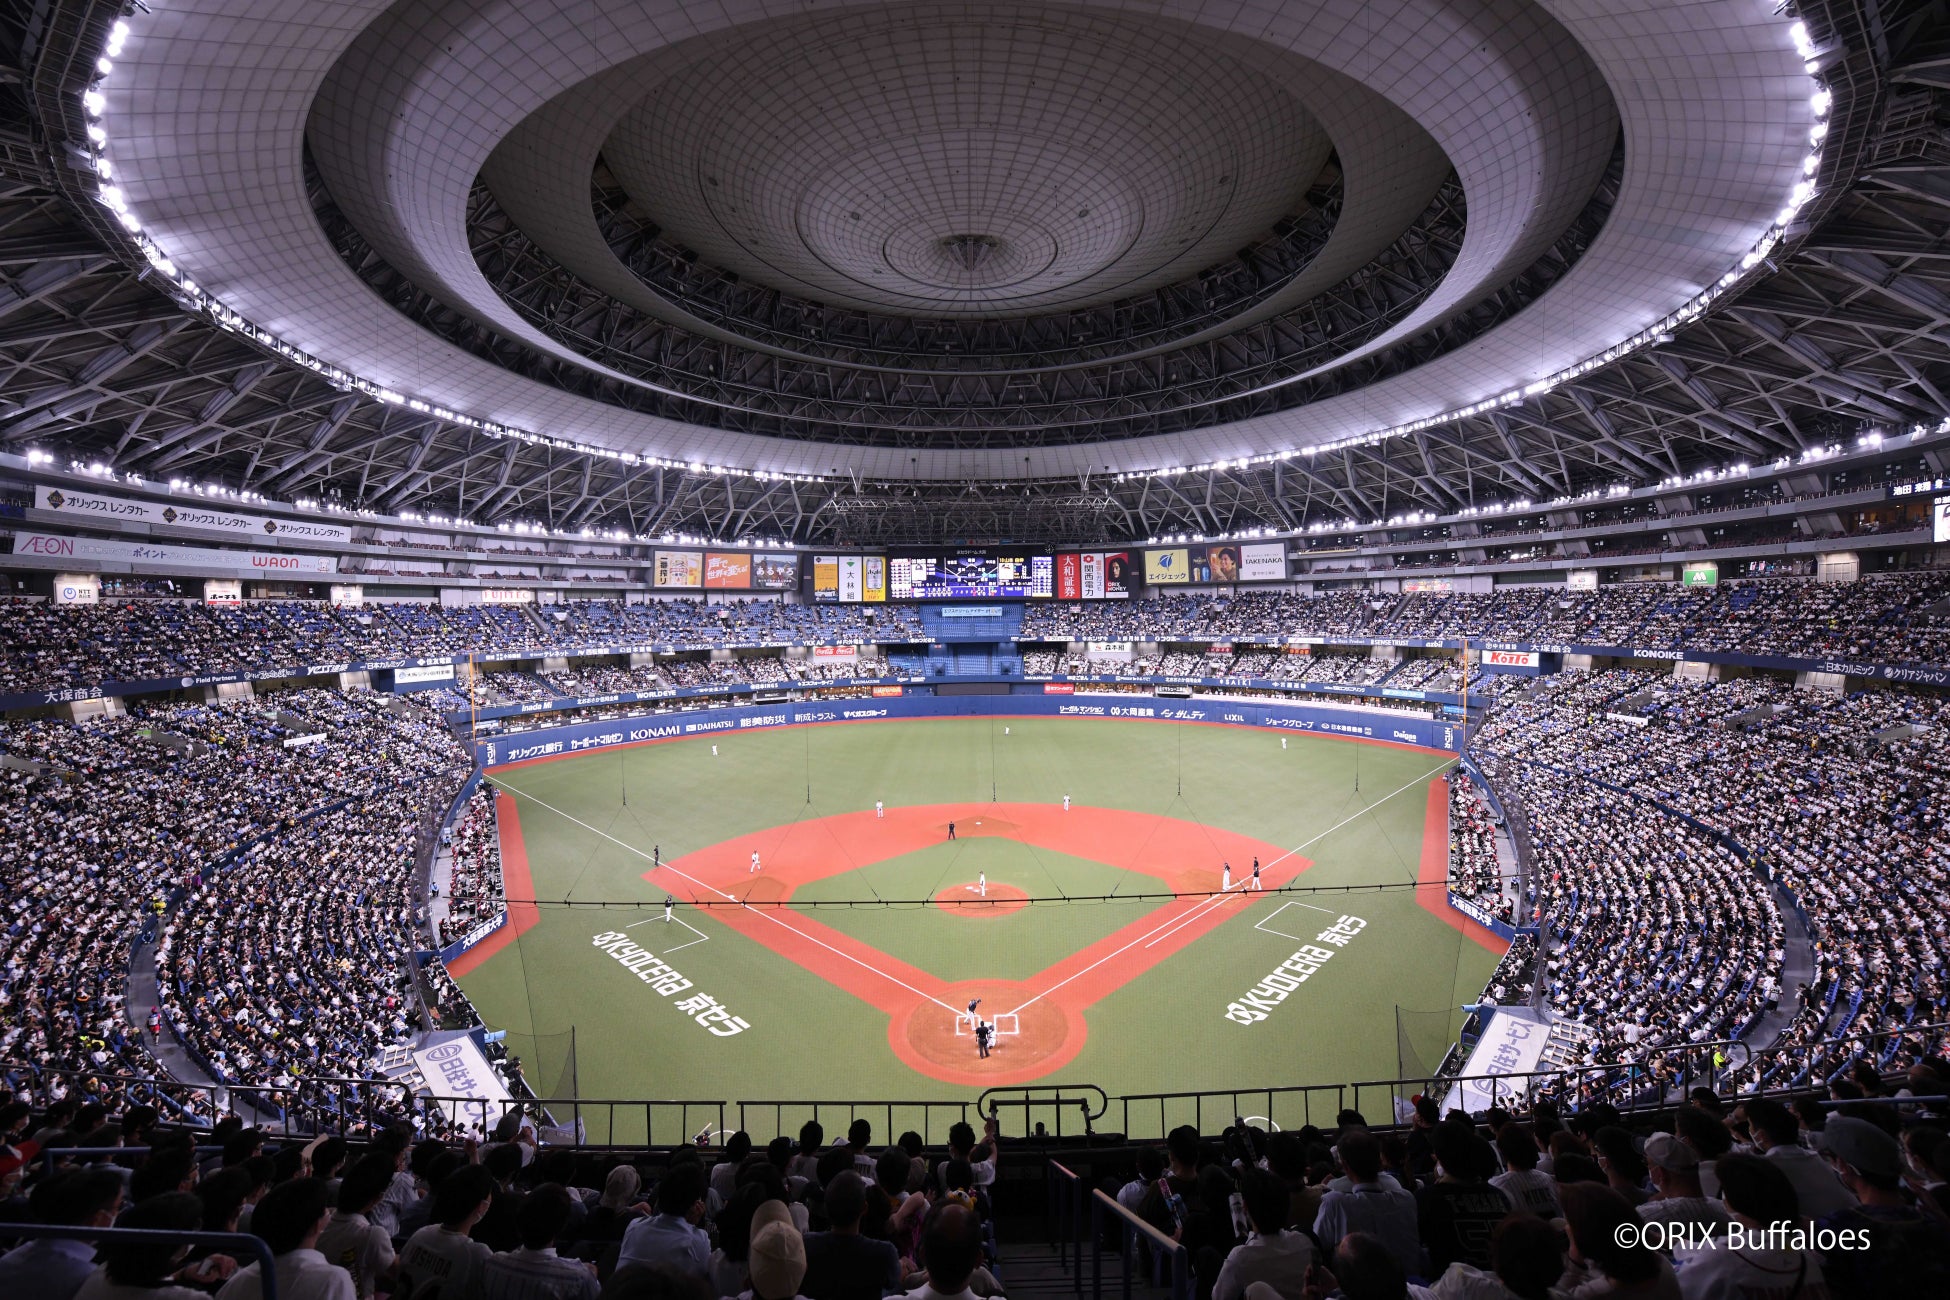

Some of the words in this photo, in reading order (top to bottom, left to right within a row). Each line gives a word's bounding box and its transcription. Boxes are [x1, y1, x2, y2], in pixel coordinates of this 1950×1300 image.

[67, 496, 108, 511] オリックス
[110, 502, 150, 516] レンタカー
[179, 512, 215, 525] オリックス
[218, 514, 252, 529] レンタカー
[279, 524, 312, 535] オリックス
[314, 528, 345, 537] レンタカー
[133, 547, 167, 559] ポイント
[252, 556, 299, 568] WAON
[1245, 557, 1283, 565] TAKENAKA
[757, 567, 794, 576] あるやろ
[1063, 556, 1075, 597] 大和証券
[1149, 572, 1186, 580] エイジェック
[846, 571, 855, 600] 大林組
[1084, 565, 1093, 597] 関西電力
[484, 590, 530, 600] FUJITEC
[1425, 640, 1443, 648] azbil
[1530, 644, 1572, 653] 大塚商会
[1633, 649, 1684, 660] KONOIKE
[366, 660, 406, 670] 日本カルミック
[1826, 662, 1875, 675] 日本カルミック
[195, 676, 211, 684] Field
[1893, 668, 1947, 683] クリアジャパン
[44, 686, 103, 704] 大塚商会
[636, 691, 663, 699] WORLD
[740, 714, 786, 728] 能美防災
[794, 712, 837, 722] 新成トラスト
[1174, 710, 1206, 720] サムティ
[1224, 713, 1244, 722] LIXIL
[697, 720, 734, 731] DAIHATSU
[1265, 717, 1314, 729] ショーワグローブ
[630, 725, 680, 741] KONAMI
[570, 733, 623, 750] カーポートマルゼン
[508, 741, 563, 760] オリックス銀行
[1248, 944, 1335, 1012] KYOCERA
[1316, 915, 1368, 948] 京セラ
[609, 932, 694, 997] KYOCERA
[674, 992, 751, 1037] 京セラ
[409, 1246, 453, 1279] OSHIDA
